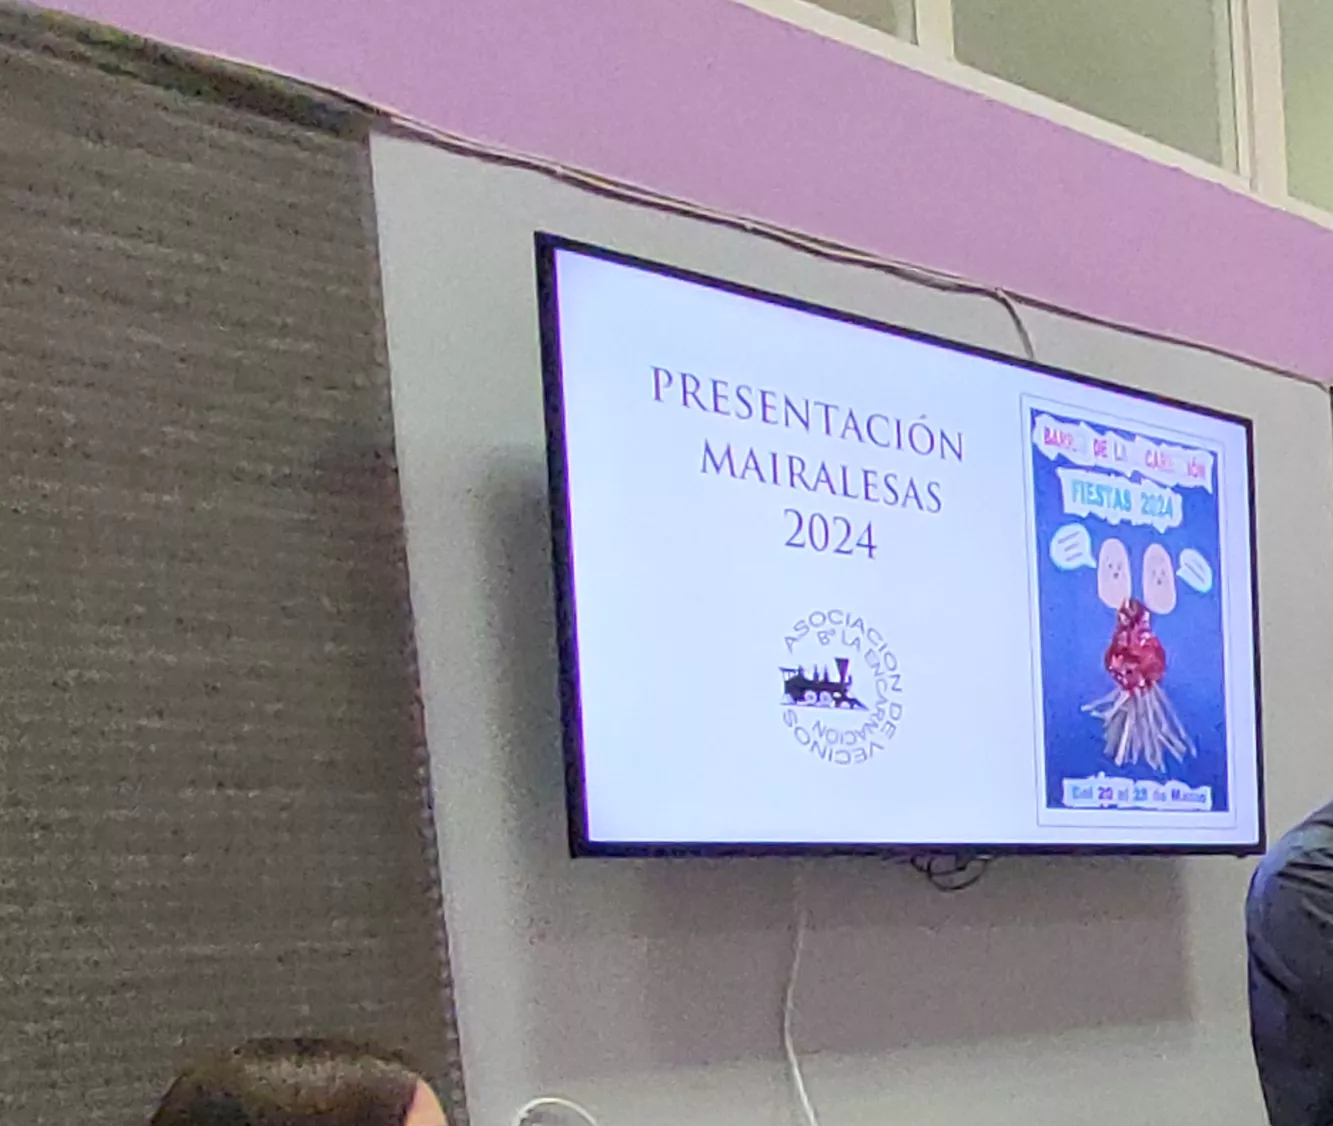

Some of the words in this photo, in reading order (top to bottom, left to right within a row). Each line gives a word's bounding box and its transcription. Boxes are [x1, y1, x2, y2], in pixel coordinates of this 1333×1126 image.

[650, 365, 963, 462] PRESENTACIÓN
[700, 439, 942, 513] MAIRALESAS
[1071, 479, 1132, 513] FIESTAS
[1140, 491, 1174, 518] 2024
[784, 508, 877, 560] 2024
[784, 609, 903, 693] ASOCIACION
[841, 630, 861, 652] LA
[783, 708, 884, 765] VECINOS
[881, 702, 903, 740] DE
